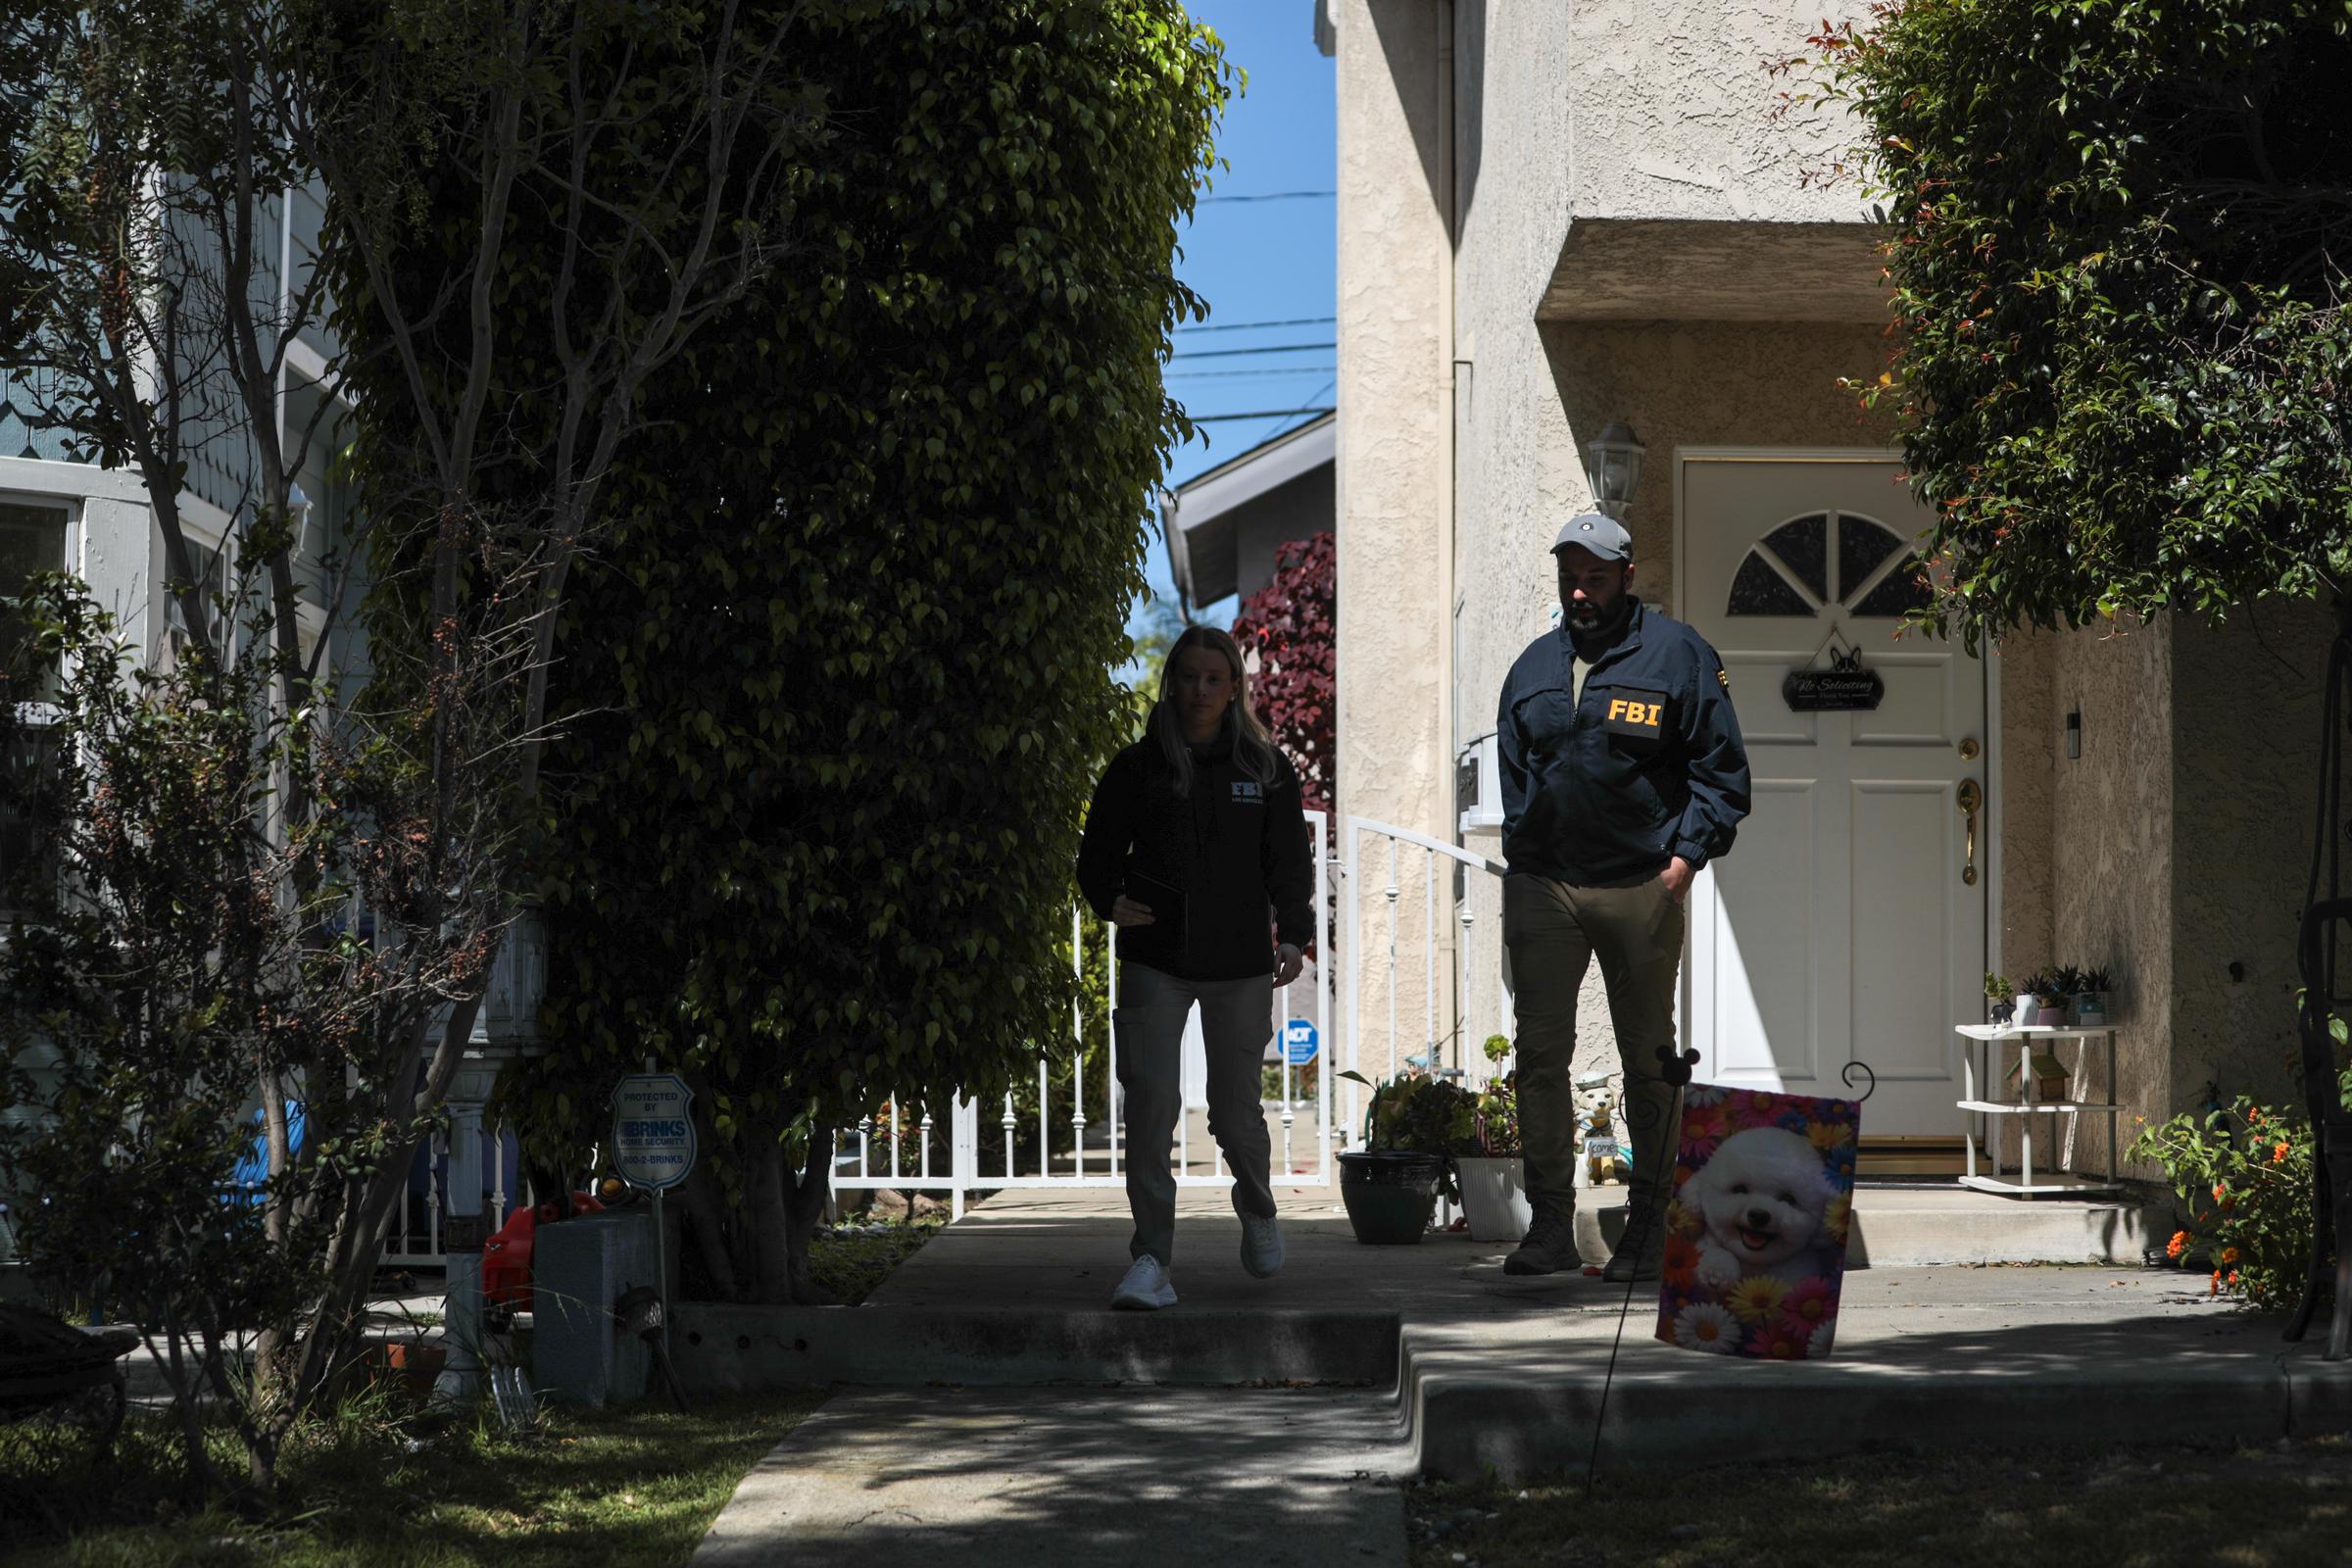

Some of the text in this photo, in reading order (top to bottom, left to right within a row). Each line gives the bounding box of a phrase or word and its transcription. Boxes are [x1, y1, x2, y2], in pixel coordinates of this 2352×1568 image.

[1607, 698, 1662, 727] FBI
[644, 1102, 658, 1111] BY
[627, 1120, 686, 1137] BRINKS
[623, 1155, 684, 1164] 800-2-BRINKS
